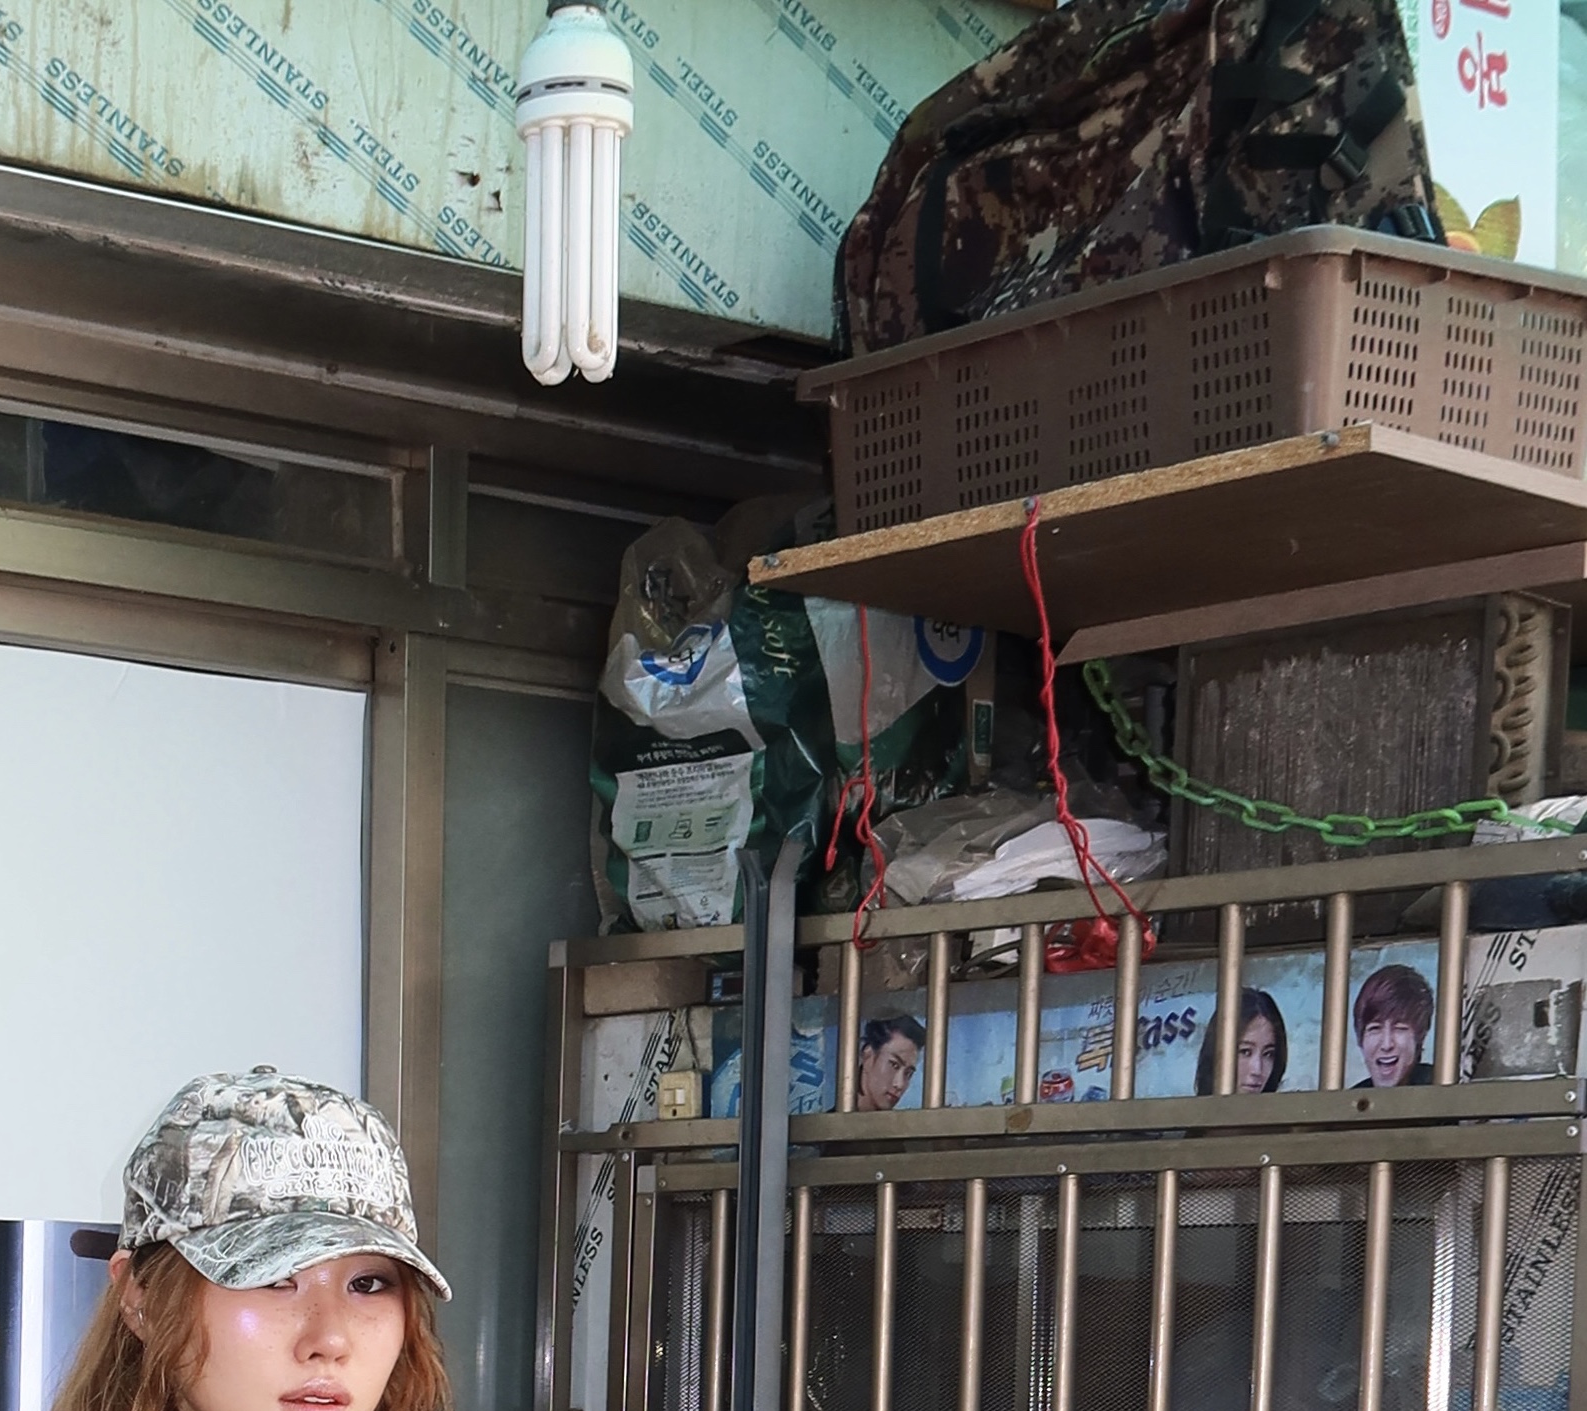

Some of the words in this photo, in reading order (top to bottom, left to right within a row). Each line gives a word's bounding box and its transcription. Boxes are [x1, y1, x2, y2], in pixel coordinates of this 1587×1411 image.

[413, 0, 518, 101] TAINLESS
[44, 56, 186, 178] STAINLESS
[349, 117, 421, 193] STEEL.
[676, 56, 739, 128] STEEL.
[753, 140, 849, 237] TAINLESS
[631, 201, 740, 309] STAINLESS
